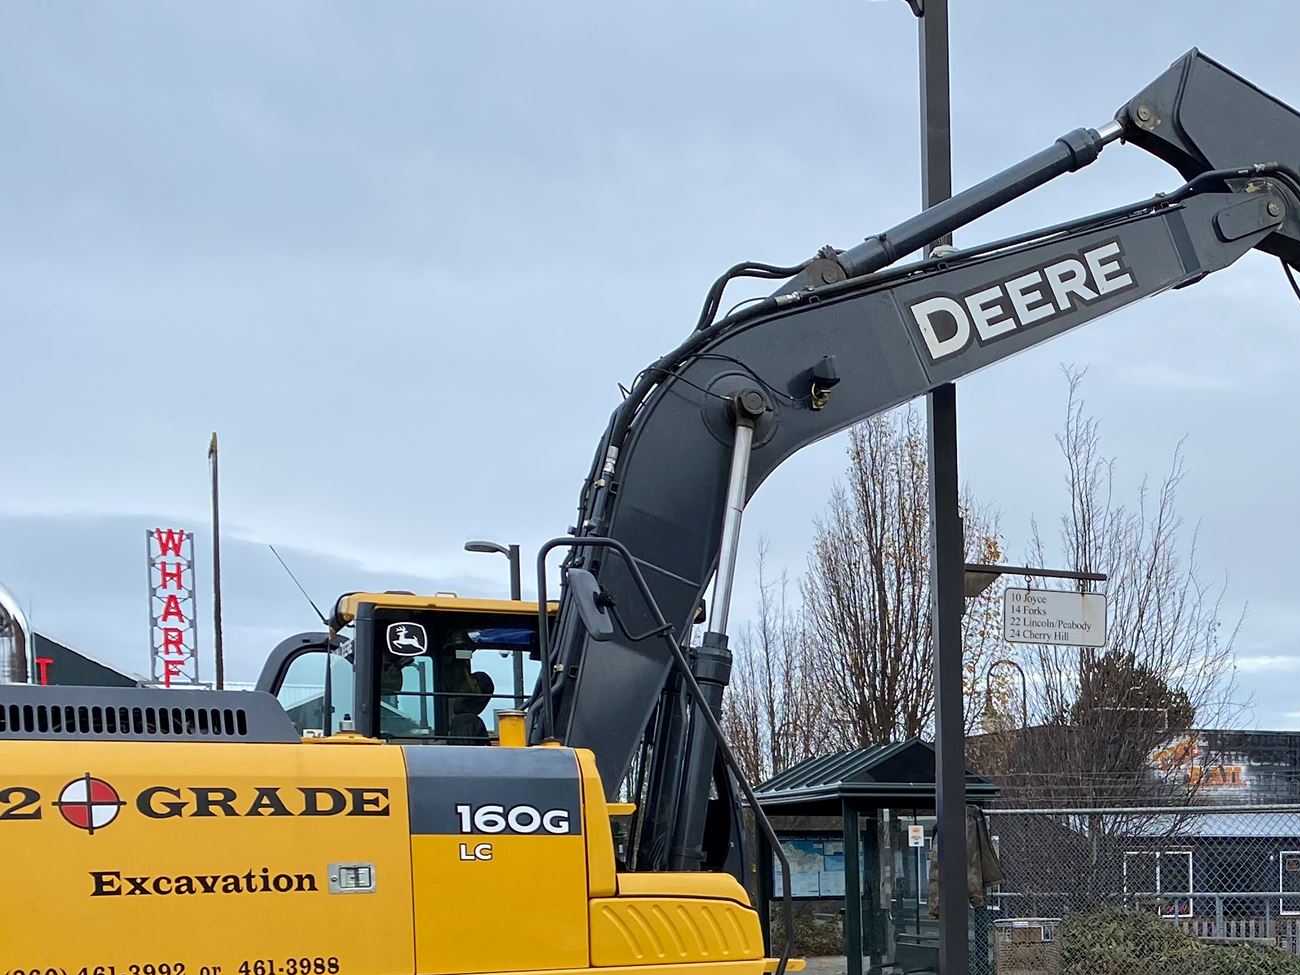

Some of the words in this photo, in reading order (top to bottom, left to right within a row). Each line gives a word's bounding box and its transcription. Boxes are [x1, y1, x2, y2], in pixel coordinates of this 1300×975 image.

[910, 241, 1133, 360] DEERE
[155, 528, 185, 688] WHARF
[1011, 593, 1021, 602] 10
[1023, 594, 1047, 605] Joyce
[1011, 605, 1021, 614] 14
[1023, 606, 1047, 615] Forks
[1010, 617, 1020, 626] 22
[1023, 618, 1092, 632] Lincoln/Peabody
[1010, 629, 1020, 638] 24
[1022, 630, 1052, 641] Cherry
[1054, 631, 1069, 641] Hill
[136, 786, 390, 819] GRADE
[456, 805, 570, 834] 160G
[460, 844, 492, 860] LC
[89, 867, 319, 897] Excavation
